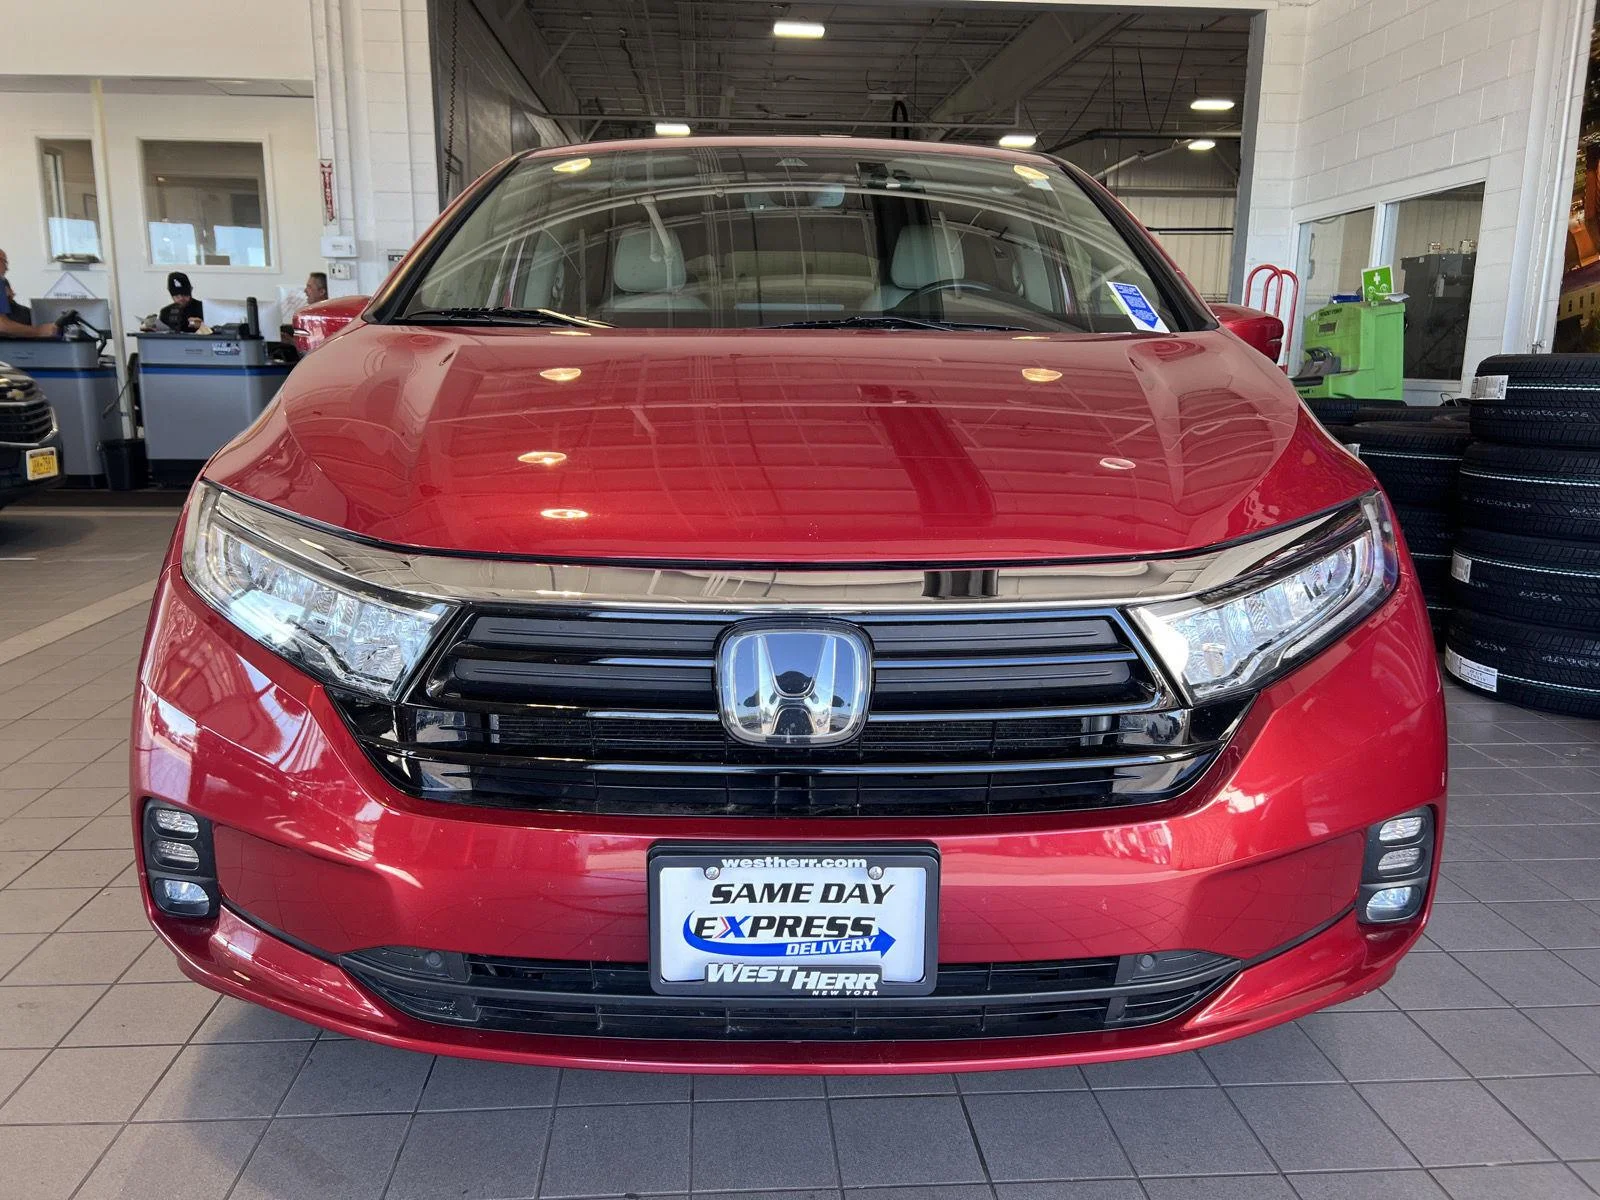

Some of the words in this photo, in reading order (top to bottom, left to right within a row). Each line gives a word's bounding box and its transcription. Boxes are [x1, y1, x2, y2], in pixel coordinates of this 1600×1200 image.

[721, 856, 868, 869] westherr.com
[709, 883, 815, 905] SAME
[819, 883, 895, 905] DAY
[693, 915, 876, 939] EXPRESS
[785, 937, 876, 957] DELIVERY
